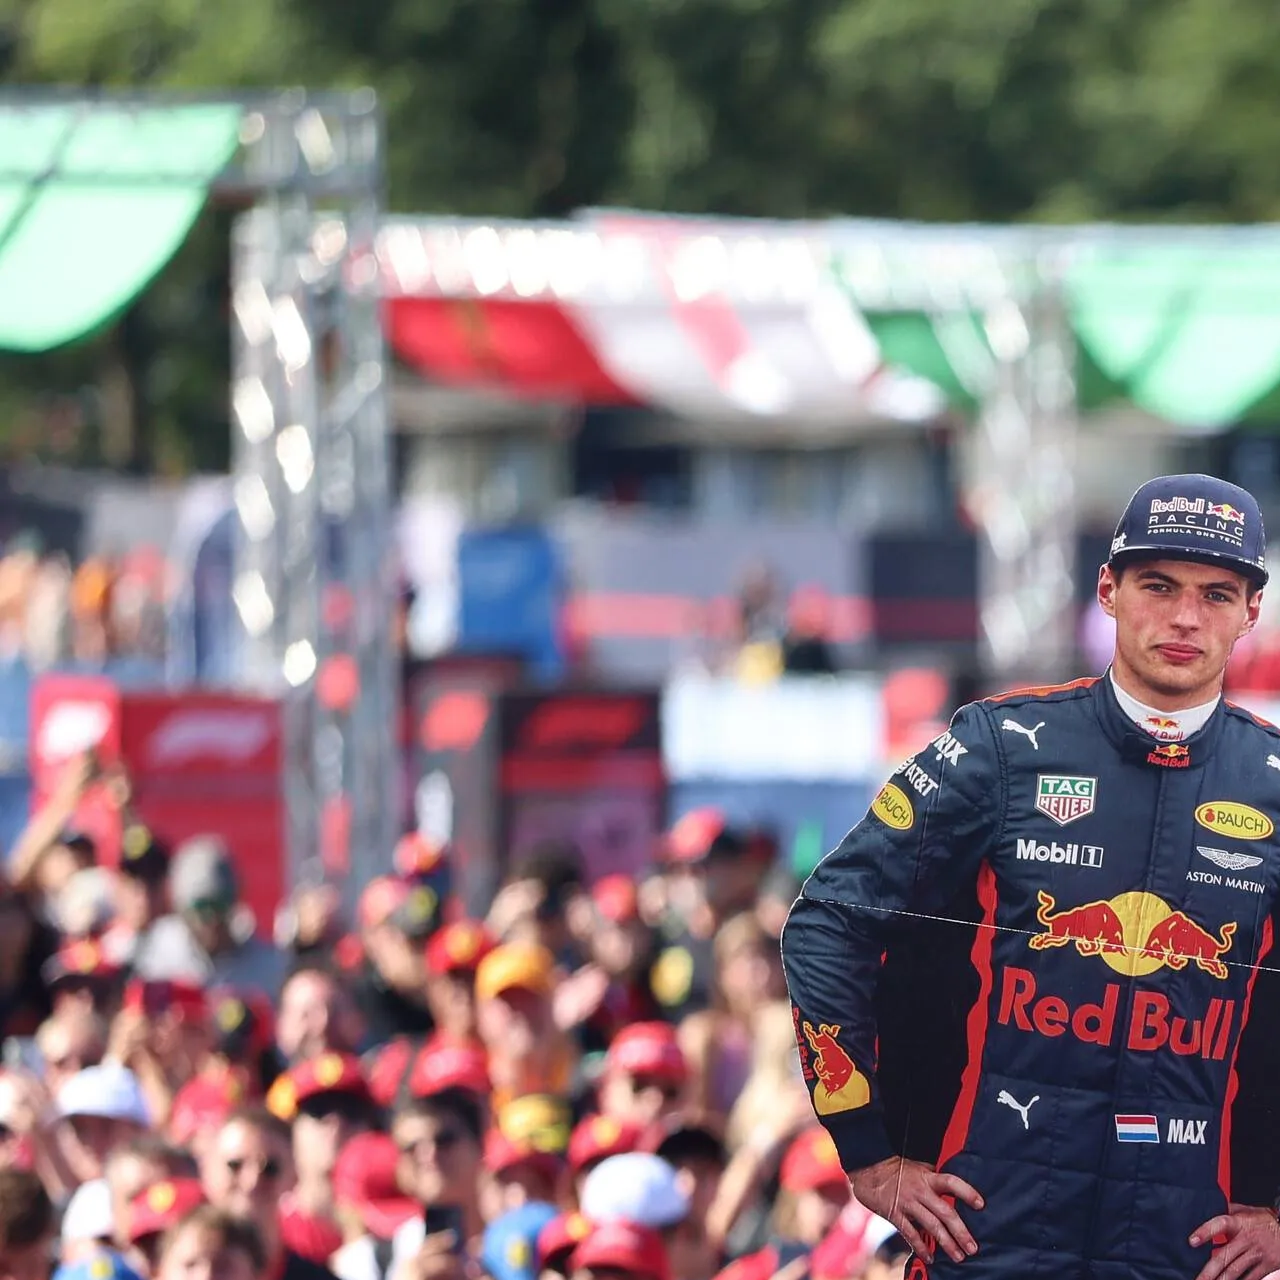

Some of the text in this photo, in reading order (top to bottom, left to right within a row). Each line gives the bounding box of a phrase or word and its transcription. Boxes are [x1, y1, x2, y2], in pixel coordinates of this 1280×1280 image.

[1150, 497, 1205, 514] Red Bull
[1147, 527, 1243, 547] FORMULA ONE TEAM
[1148, 514, 1244, 537] RACING
[1146, 752, 1190, 768] Red Bull
[904, 763, 939, 797] AT&T
[1043, 778, 1090, 796] TAG
[880, 791, 910, 825] RAUCH
[1041, 797, 1090, 820] HEUER
[1217, 811, 1264, 833] RAUCH
[1016, 839, 1077, 865] Mobil
[1186, 871, 1266, 895] ASTON MARTIN
[998, 966, 1235, 1061] Red Bull
[1167, 1119, 1208, 1145] MAX
